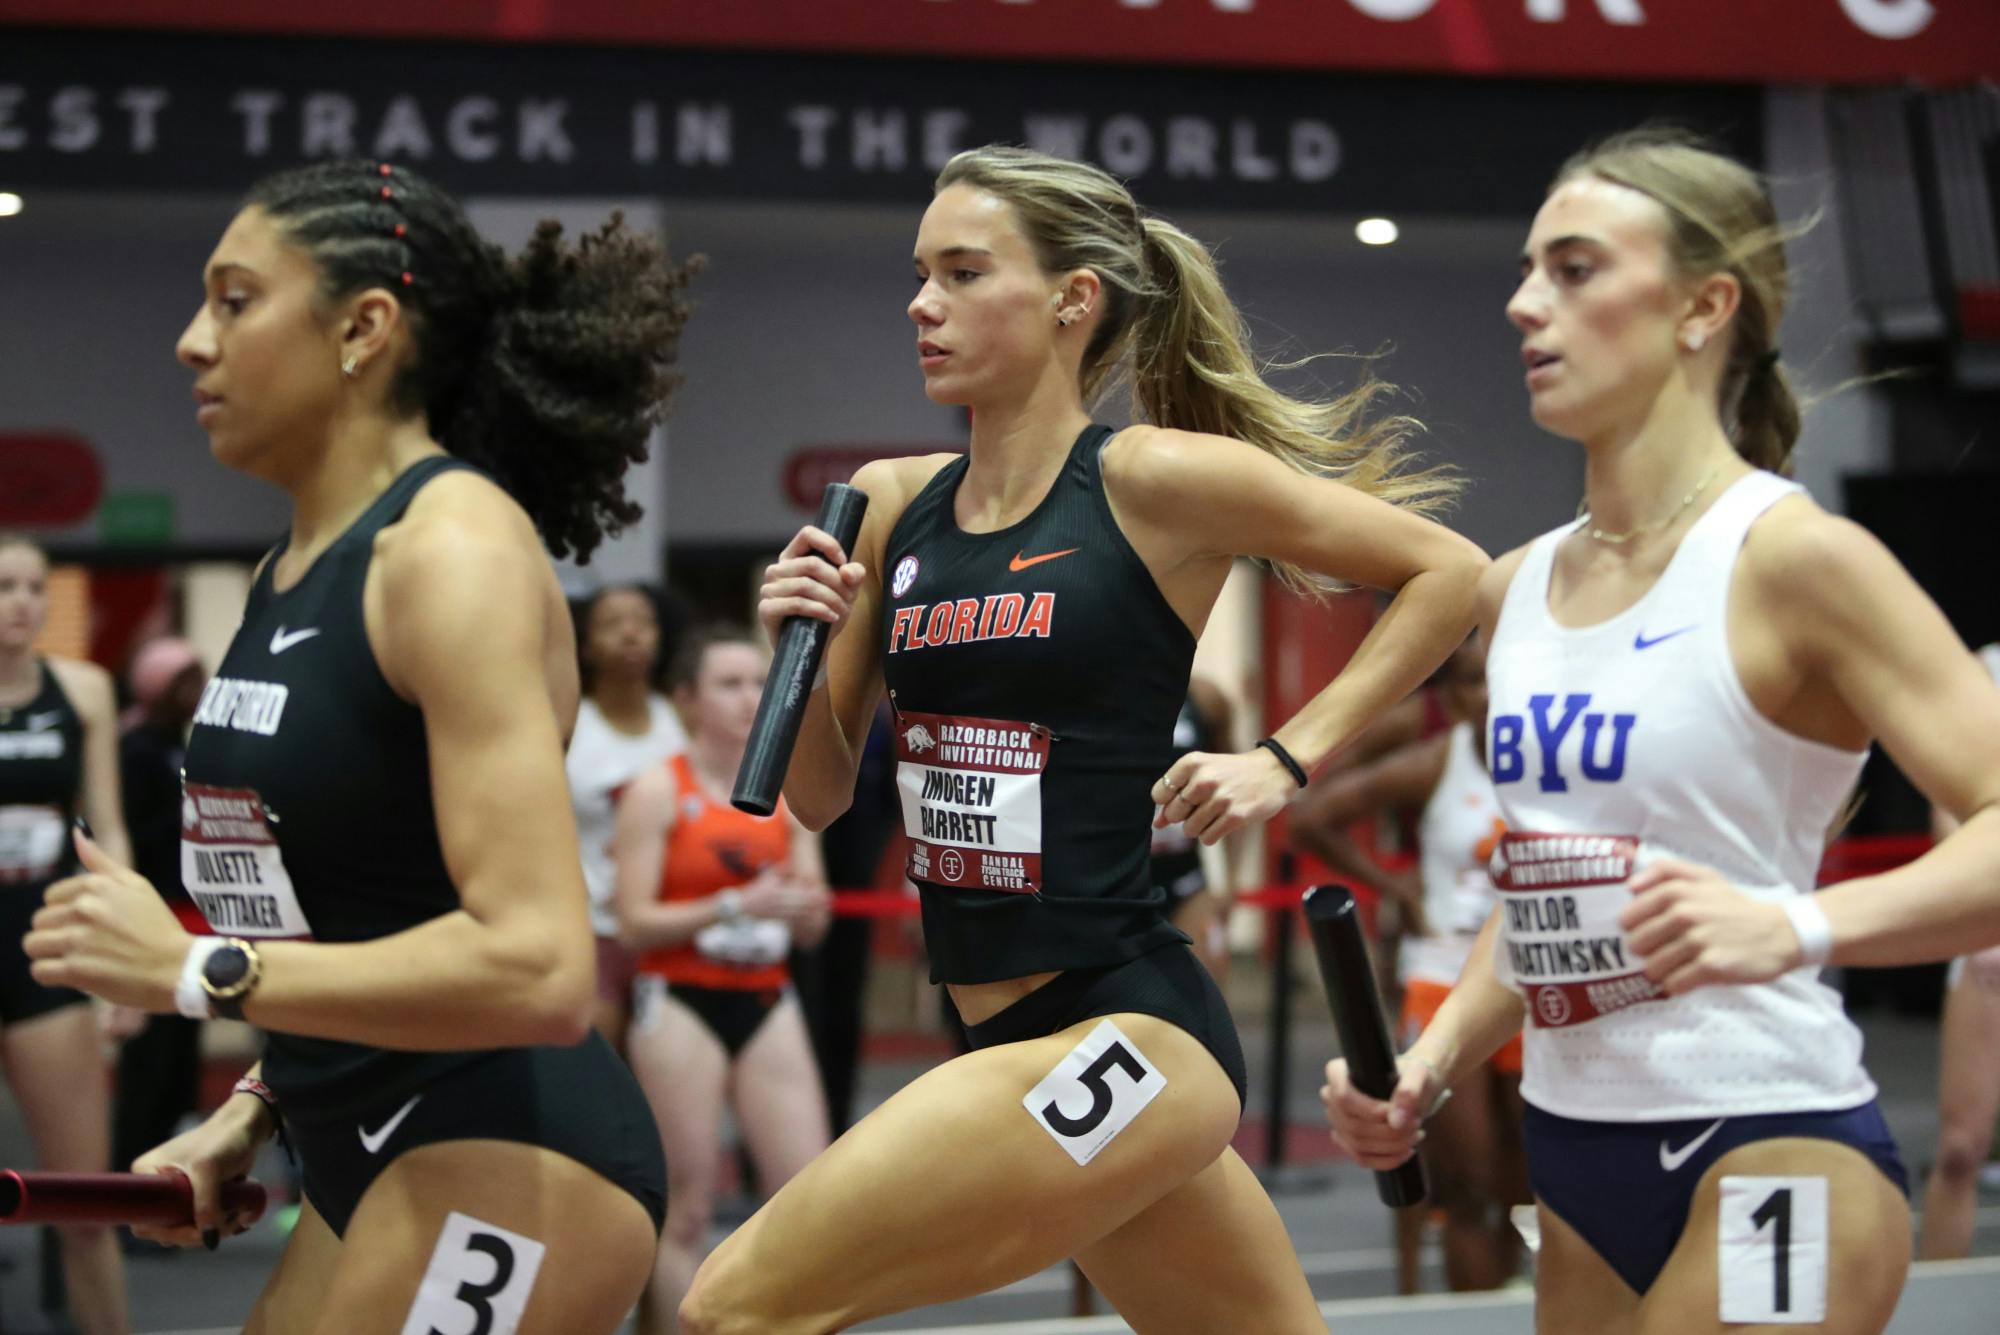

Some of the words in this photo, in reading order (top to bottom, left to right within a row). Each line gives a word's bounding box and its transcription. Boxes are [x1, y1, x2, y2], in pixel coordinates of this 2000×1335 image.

[233, 94, 575, 163] TRACK
[631, 102, 733, 166] IN
[789, 107, 970, 171] THE
[1022, 114, 1343, 181] WORLD
[888, 592, 1056, 654] FLORIDA
[940, 724, 1031, 749] RAZORBACK
[940, 744, 1042, 769] INVITATIONAL
[1493, 693, 1636, 793] BYU
[920, 805, 998, 845] BARRETT
[921, 769, 996, 807] IMOGEN
[1041, 1040, 1148, 1138] 5
[427, 1233, 515, 1335] 3
[1750, 1188, 1792, 1312] 1
